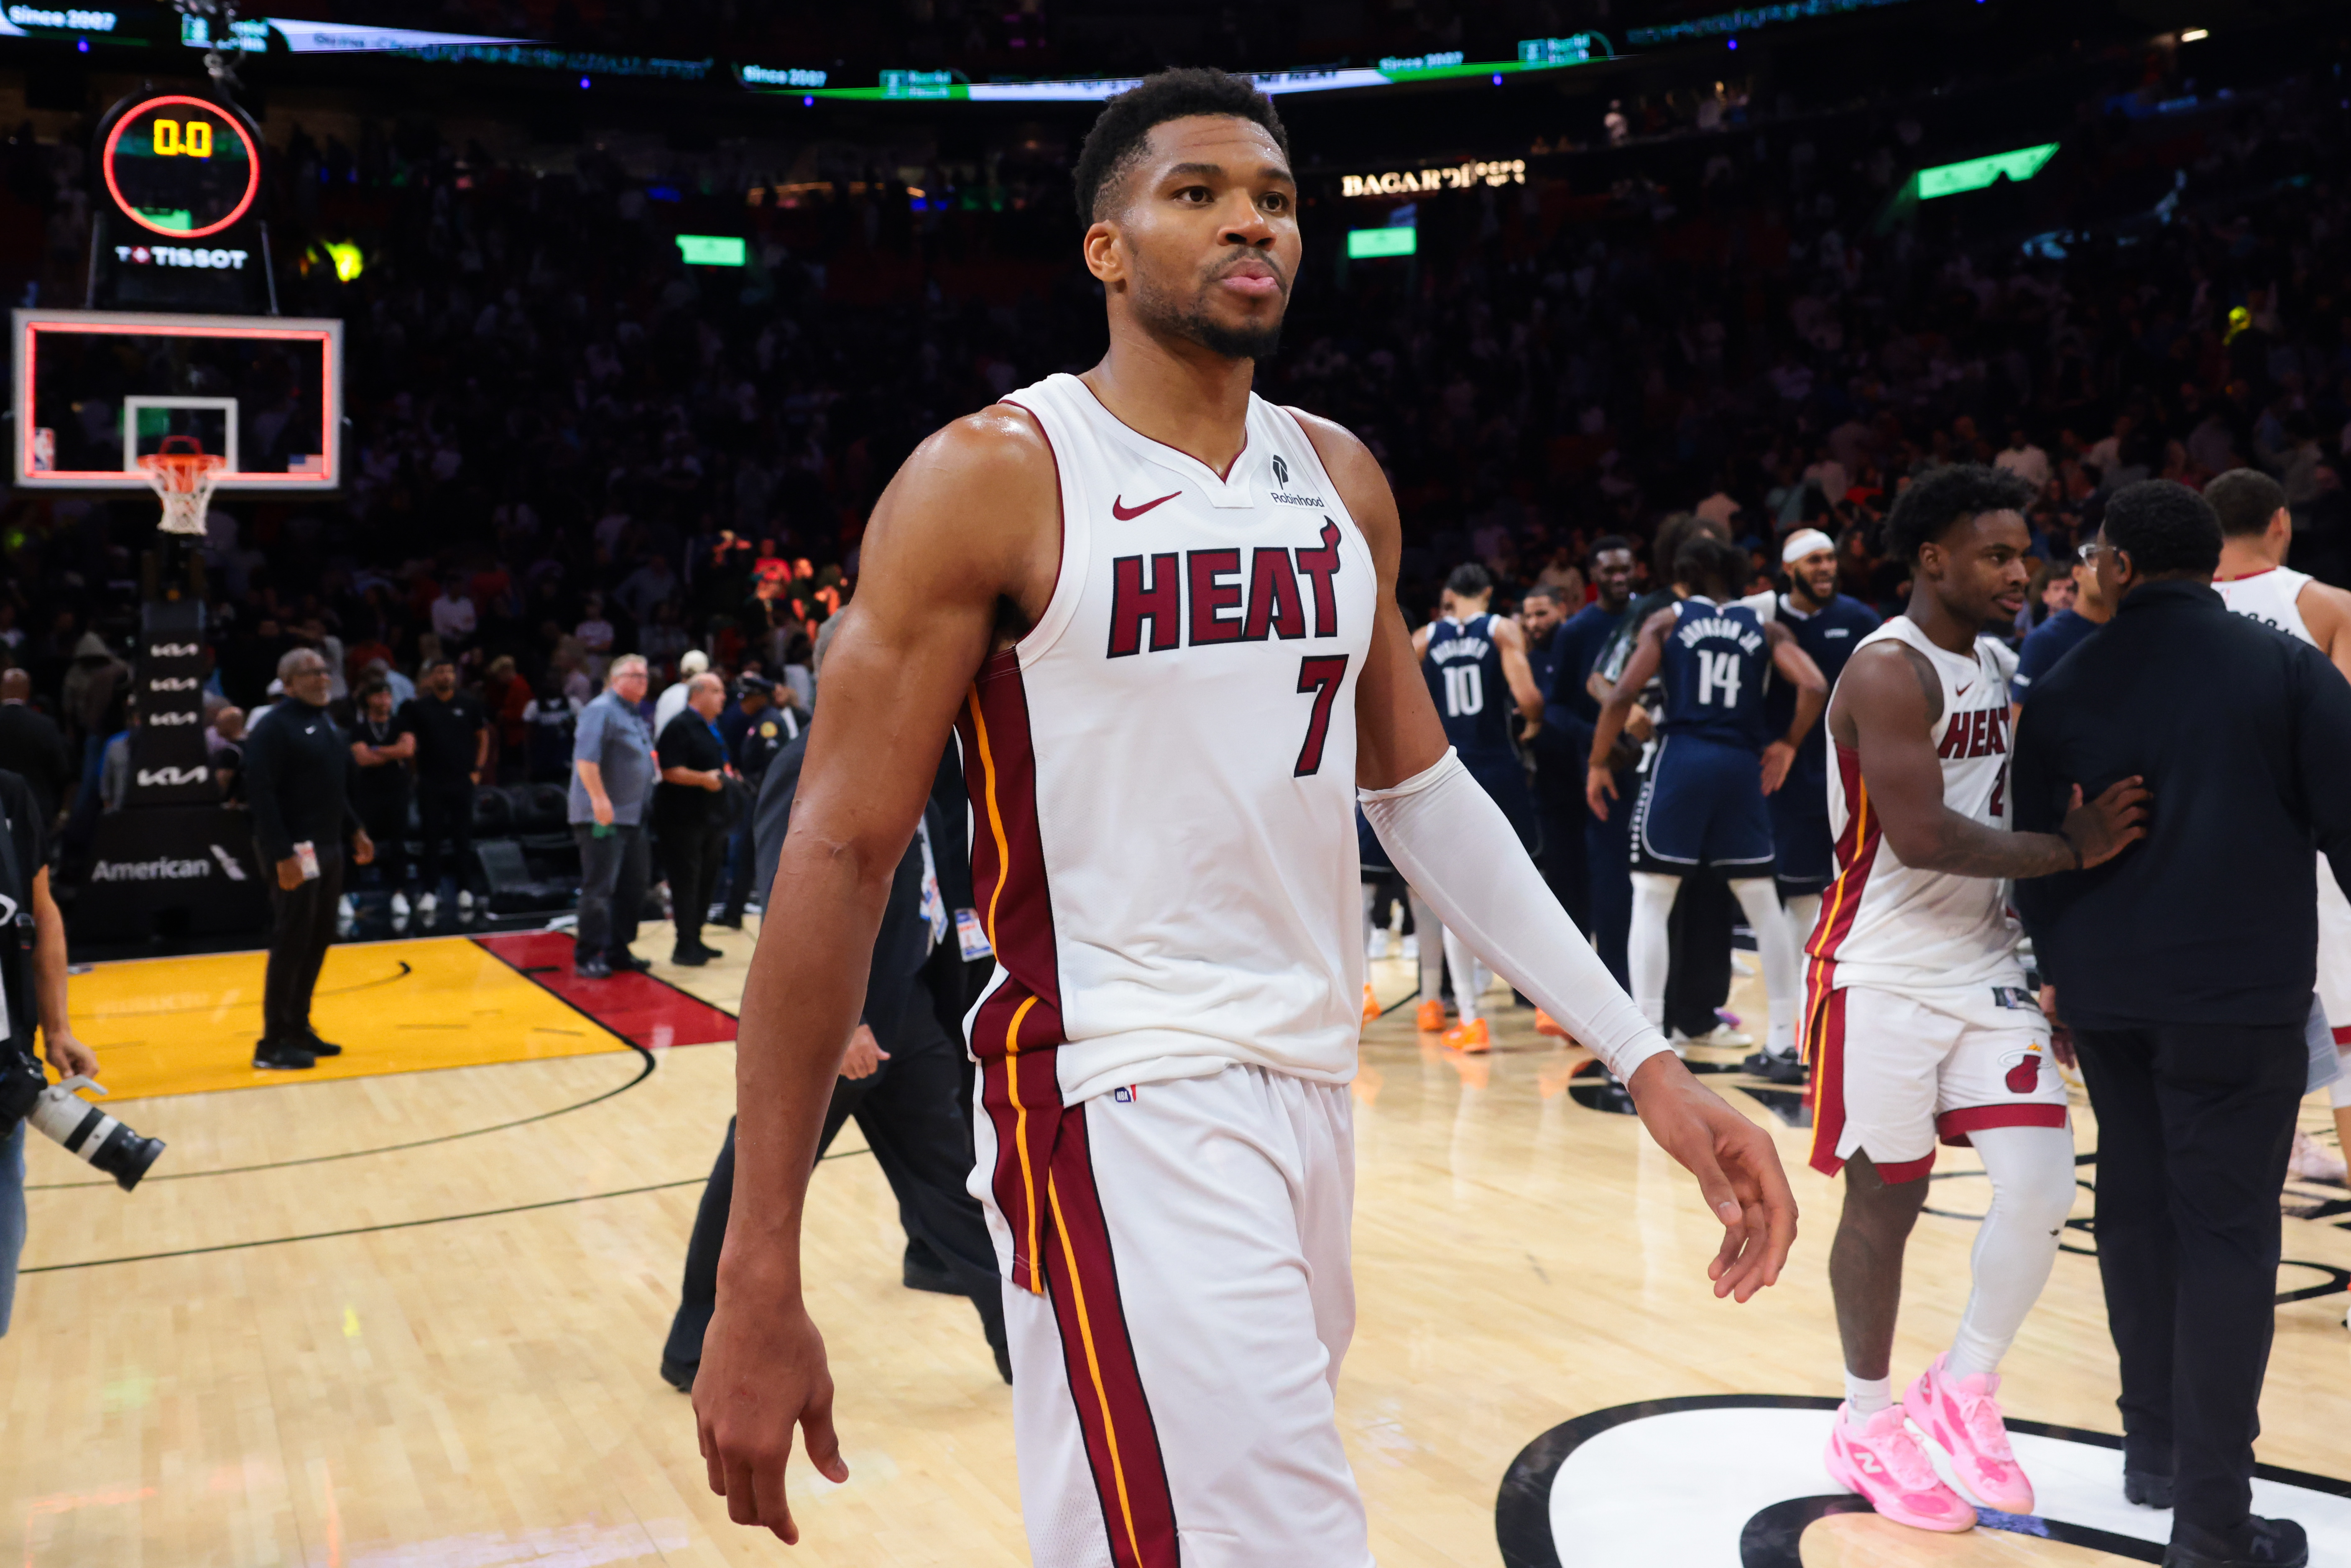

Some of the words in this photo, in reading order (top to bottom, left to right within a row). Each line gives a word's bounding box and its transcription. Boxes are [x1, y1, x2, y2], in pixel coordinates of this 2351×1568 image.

[153, 119, 212, 157] 0.0
[150, 246, 248, 269] TISSOT
[1270, 492, 1325, 507] Robinhood
[1106, 515, 1342, 659] HEAT
[1678, 617, 1742, 649] JOHNSON
[1442, 664, 1483, 718] 10
[1697, 649, 1742, 708] 14
[1294, 654, 1349, 778] 7
[90, 856, 210, 882] American
[1116, 1090, 1129, 1101] NBA
